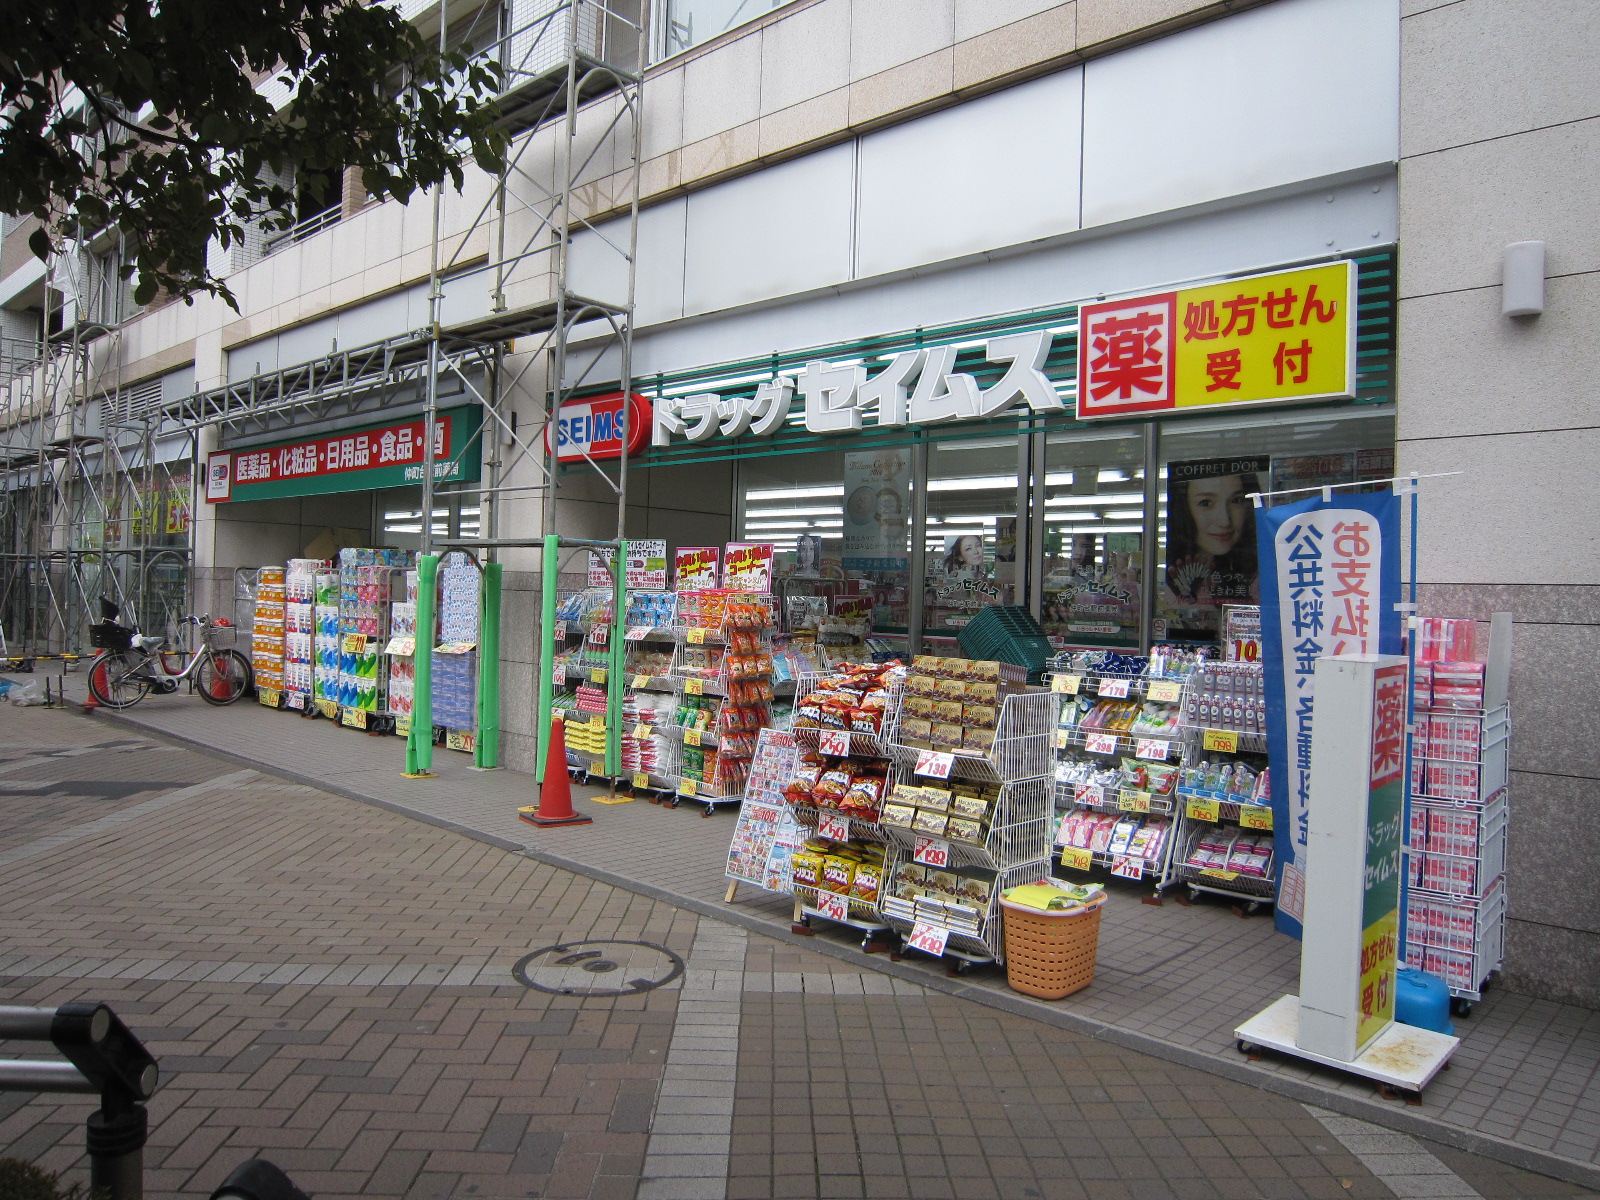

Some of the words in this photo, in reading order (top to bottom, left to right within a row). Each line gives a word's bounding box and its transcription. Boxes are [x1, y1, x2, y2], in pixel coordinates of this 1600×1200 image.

[1184, 285, 1337, 343] 処方せん
[1090, 311, 1163, 401] 薬
[558, 410, 627, 447] SEIMS
[1176, 463, 1225, 476] COFFRET
[1231, 460, 1259, 472] D'OR
[1374, 681, 1402, 773] 薬
[927, 761, 947, 777] 138
[1360, 930, 1395, 977] 処方せん
